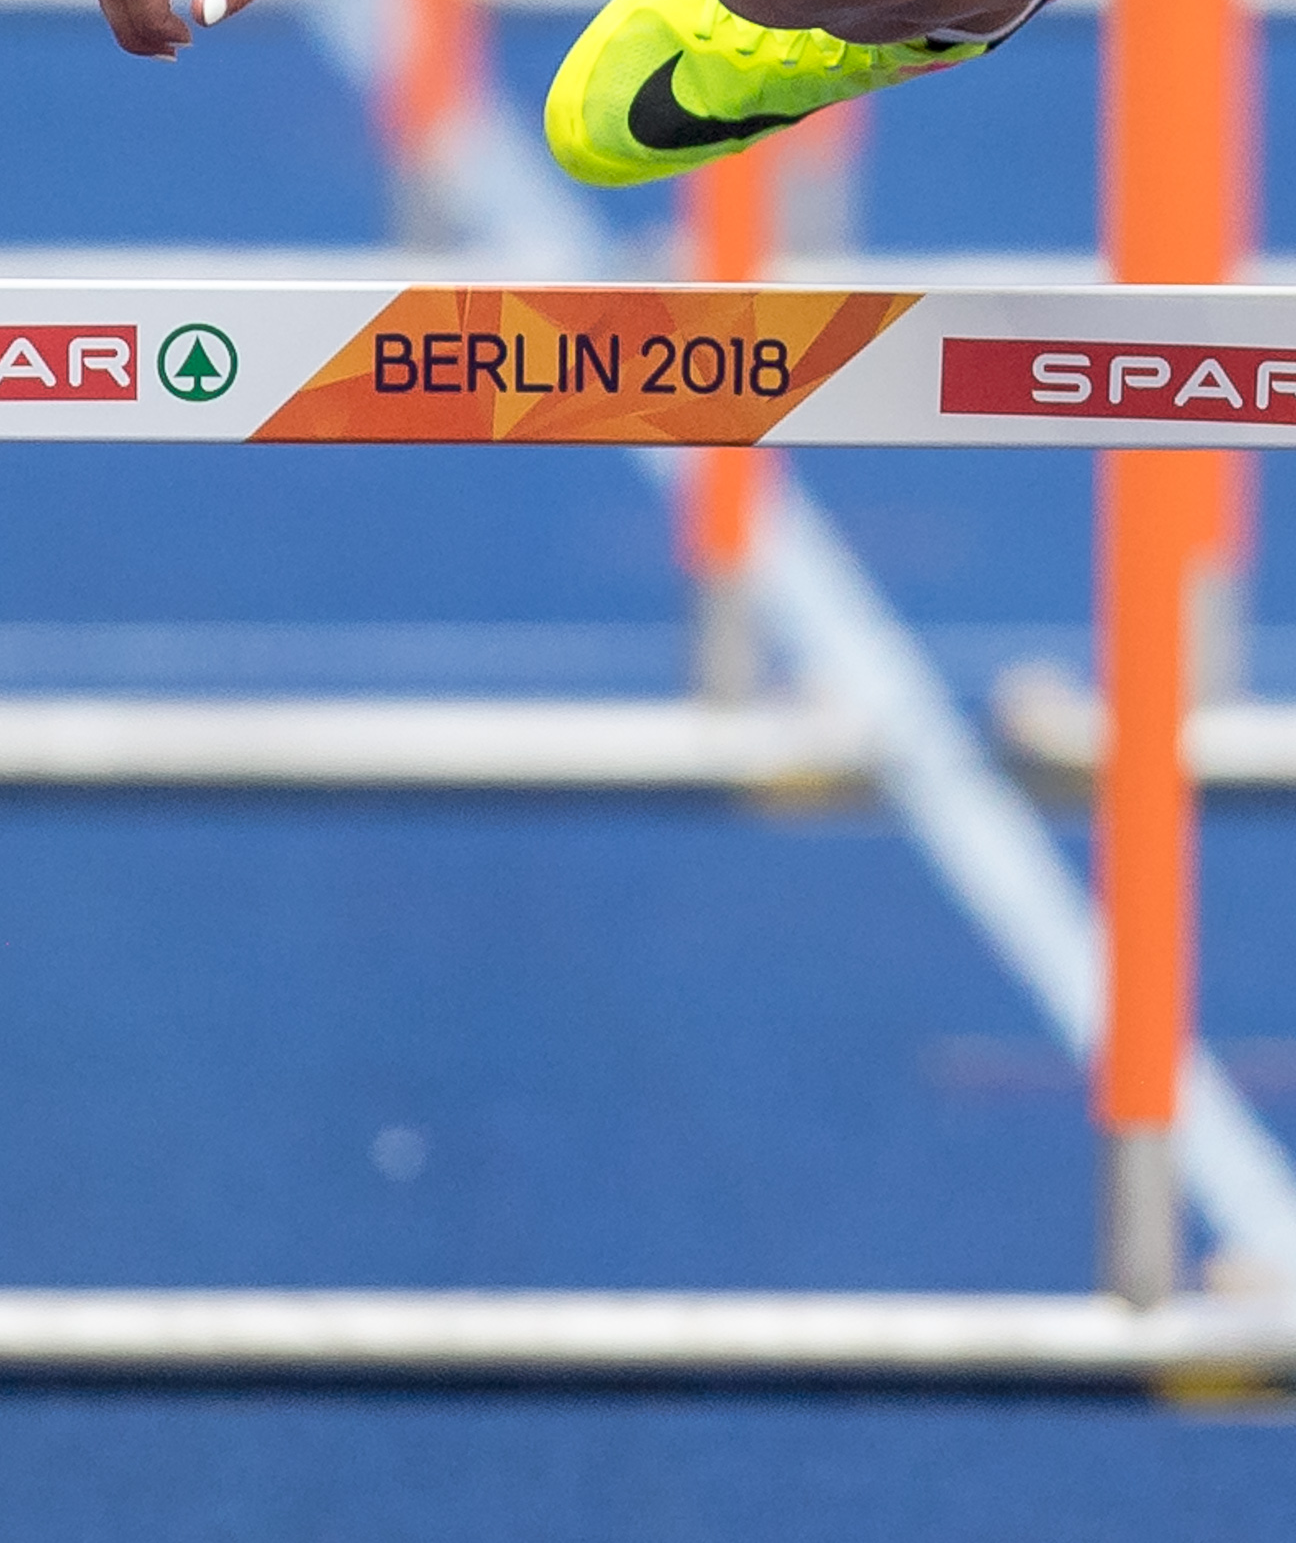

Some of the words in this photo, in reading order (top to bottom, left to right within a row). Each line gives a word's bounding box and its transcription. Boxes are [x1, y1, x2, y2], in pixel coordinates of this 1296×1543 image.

[0, 336, 131, 388] AR
[375, 332, 620, 395] BERLIN
[641, 337, 790, 398] 2018
